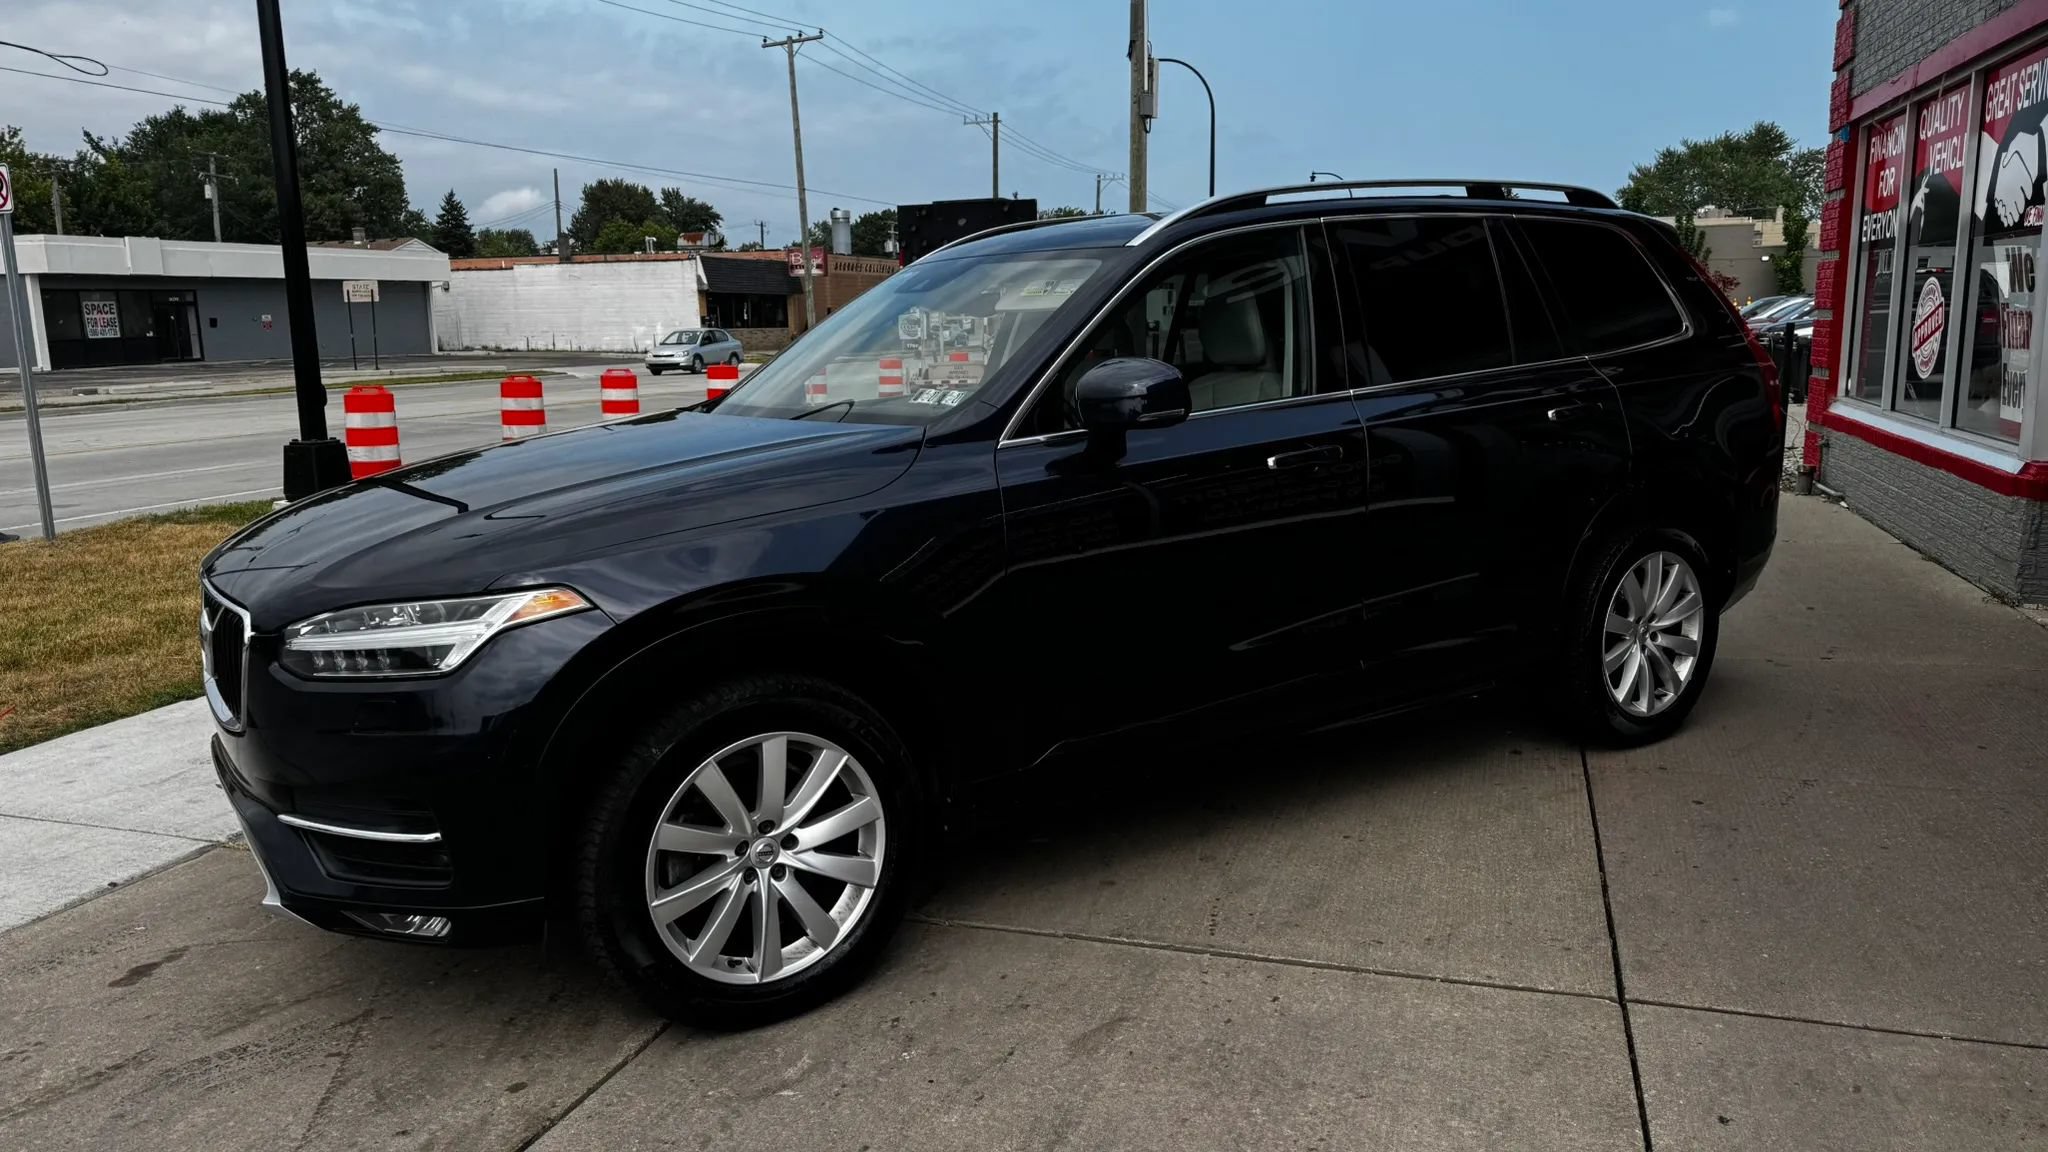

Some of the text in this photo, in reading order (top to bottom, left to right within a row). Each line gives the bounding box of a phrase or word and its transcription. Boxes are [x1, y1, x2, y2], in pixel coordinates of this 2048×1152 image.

[1986, 57, 2048, 124] GREAT SERVI
[1920, 91, 1965, 141] QUALITY
[1869, 124, 1906, 165] FINANCIN
[1929, 132, 1967, 176] VEHICL
[1878, 167, 1896, 199] FOR
[1862, 208, 1898, 242] EVERYON
[84, 303, 116, 316] SPACE
[86, 316, 118, 328] FOR LEASE
[1914, 305, 1943, 348] APPROVED
[2001, 302, 2033, 350] Finan
